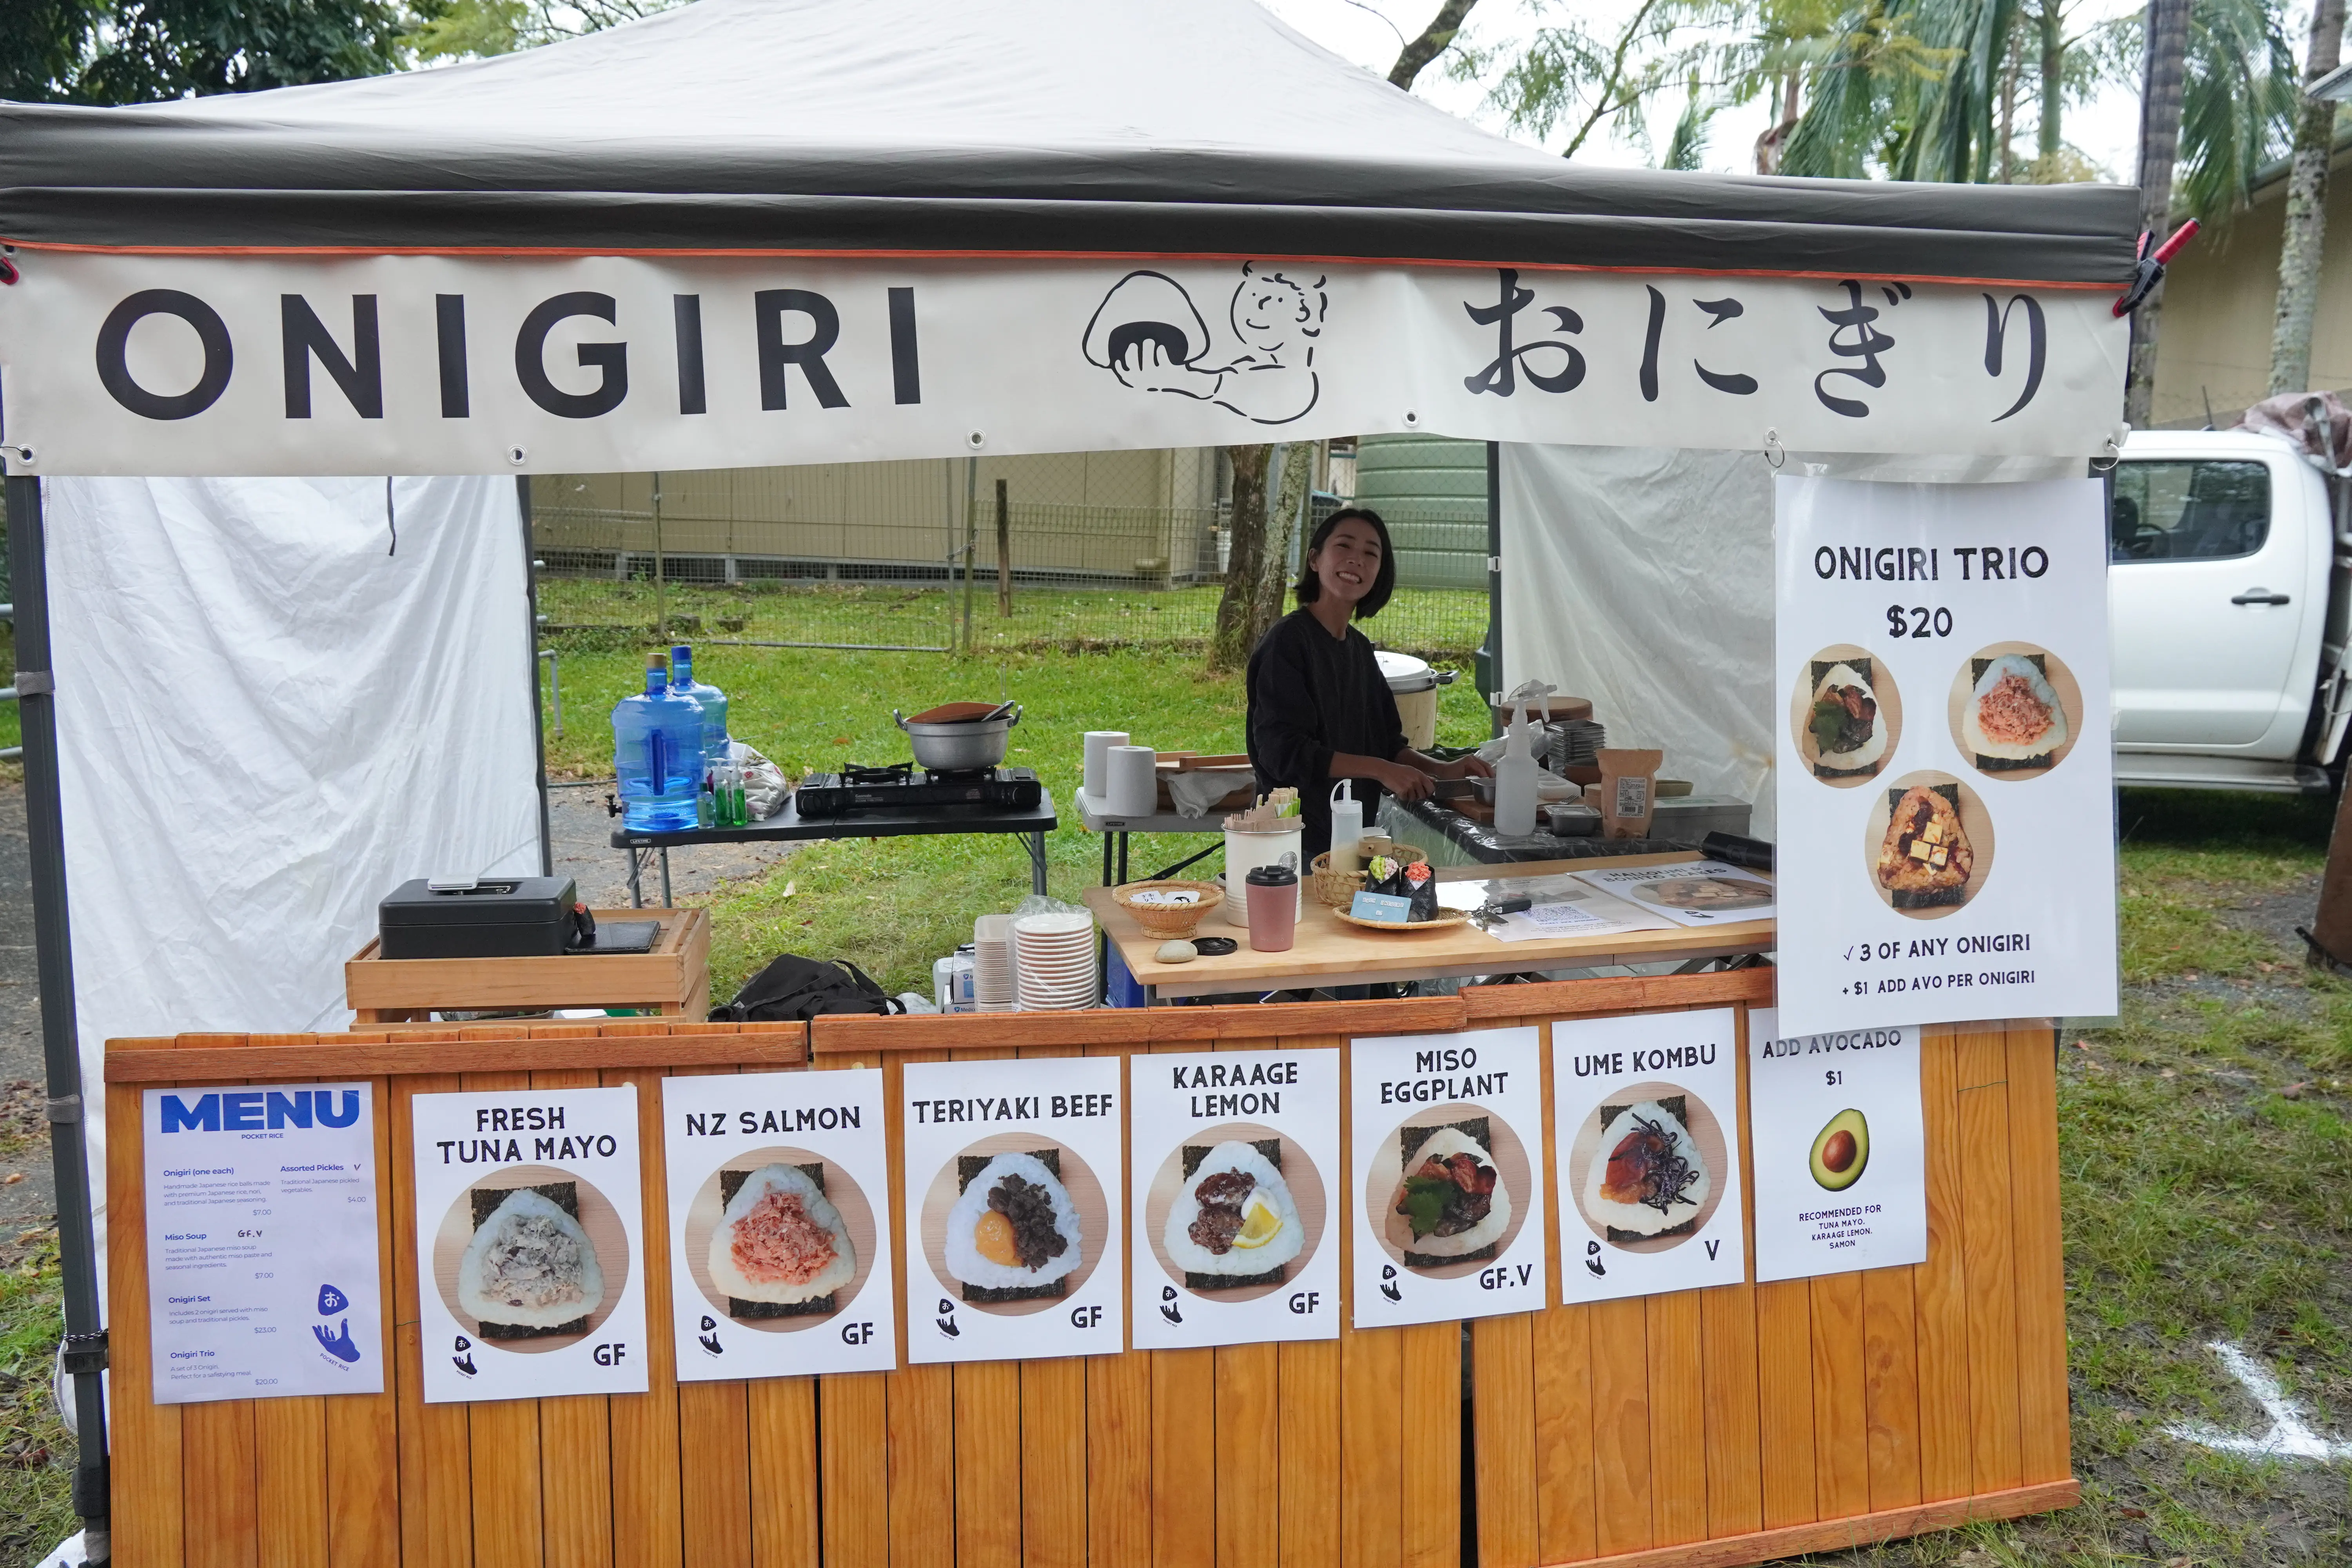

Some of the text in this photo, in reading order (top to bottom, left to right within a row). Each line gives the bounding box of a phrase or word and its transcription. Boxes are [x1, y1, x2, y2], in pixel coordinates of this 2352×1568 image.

[95, 286, 921, 421] ONIGIRI
[1463, 267, 2047, 422] おにぎり
[1814, 545, 2049, 582] ONIGIRI TRIO
[1887, 605, 1953, 638] $20
[1609, 868, 1688, 877] HALLOUMI
[1669, 868, 1728, 878] FLAKES
[1859, 934, 2030, 961] 3 OF ANY ONIGIRI
[1855, 981, 1867, 995] $1
[1878, 978, 1906, 993] ADD
[1912, 976, 1942, 990] AVO
[1948, 974, 1973, 987] PER
[1979, 971, 2035, 985] ONIGIRI
[1762, 1030, 1901, 1058] ADD AVOCADO
[1416, 1048, 1477, 1073] MISO
[1574, 1044, 1717, 1077] UME KOMBU
[1173, 1062, 1298, 1089] KARAAGE
[1826, 1071, 1843, 1085] $1
[1381, 1072, 1508, 1104] EGGPLANT
[160, 1090, 360, 1133] MENU
[913, 1094, 1112, 1123] TERIYAKI BEEF
[1192, 1092, 1281, 1118] LEMON
[476, 1107, 565, 1132] FRESH
[686, 1106, 861, 1136] NZ SALMON
[437, 1134, 617, 1164] TUNA MAYO
[163, 1169, 191, 1177] Onigiri
[1799, 1205, 1881, 1221] RECOMMENDED FOR
[1812, 1231, 1844, 1241] KARAAGE
[1829, 1240, 1855, 1249] SAMON
[1704, 1240, 1720, 1261] V
[324, 1291, 340, 1307] お
[942, 1302, 950, 1310] お
[1289, 1292, 1319, 1315] GF
[1071, 1306, 1102, 1329] GF
[458, 1339, 466, 1348] お
[841, 1322, 874, 1346] GF
[171, 1351, 198, 1359] Onigiri
[319, 1353, 338, 1366] POCKET
[593, 1343, 626, 1367] GF
